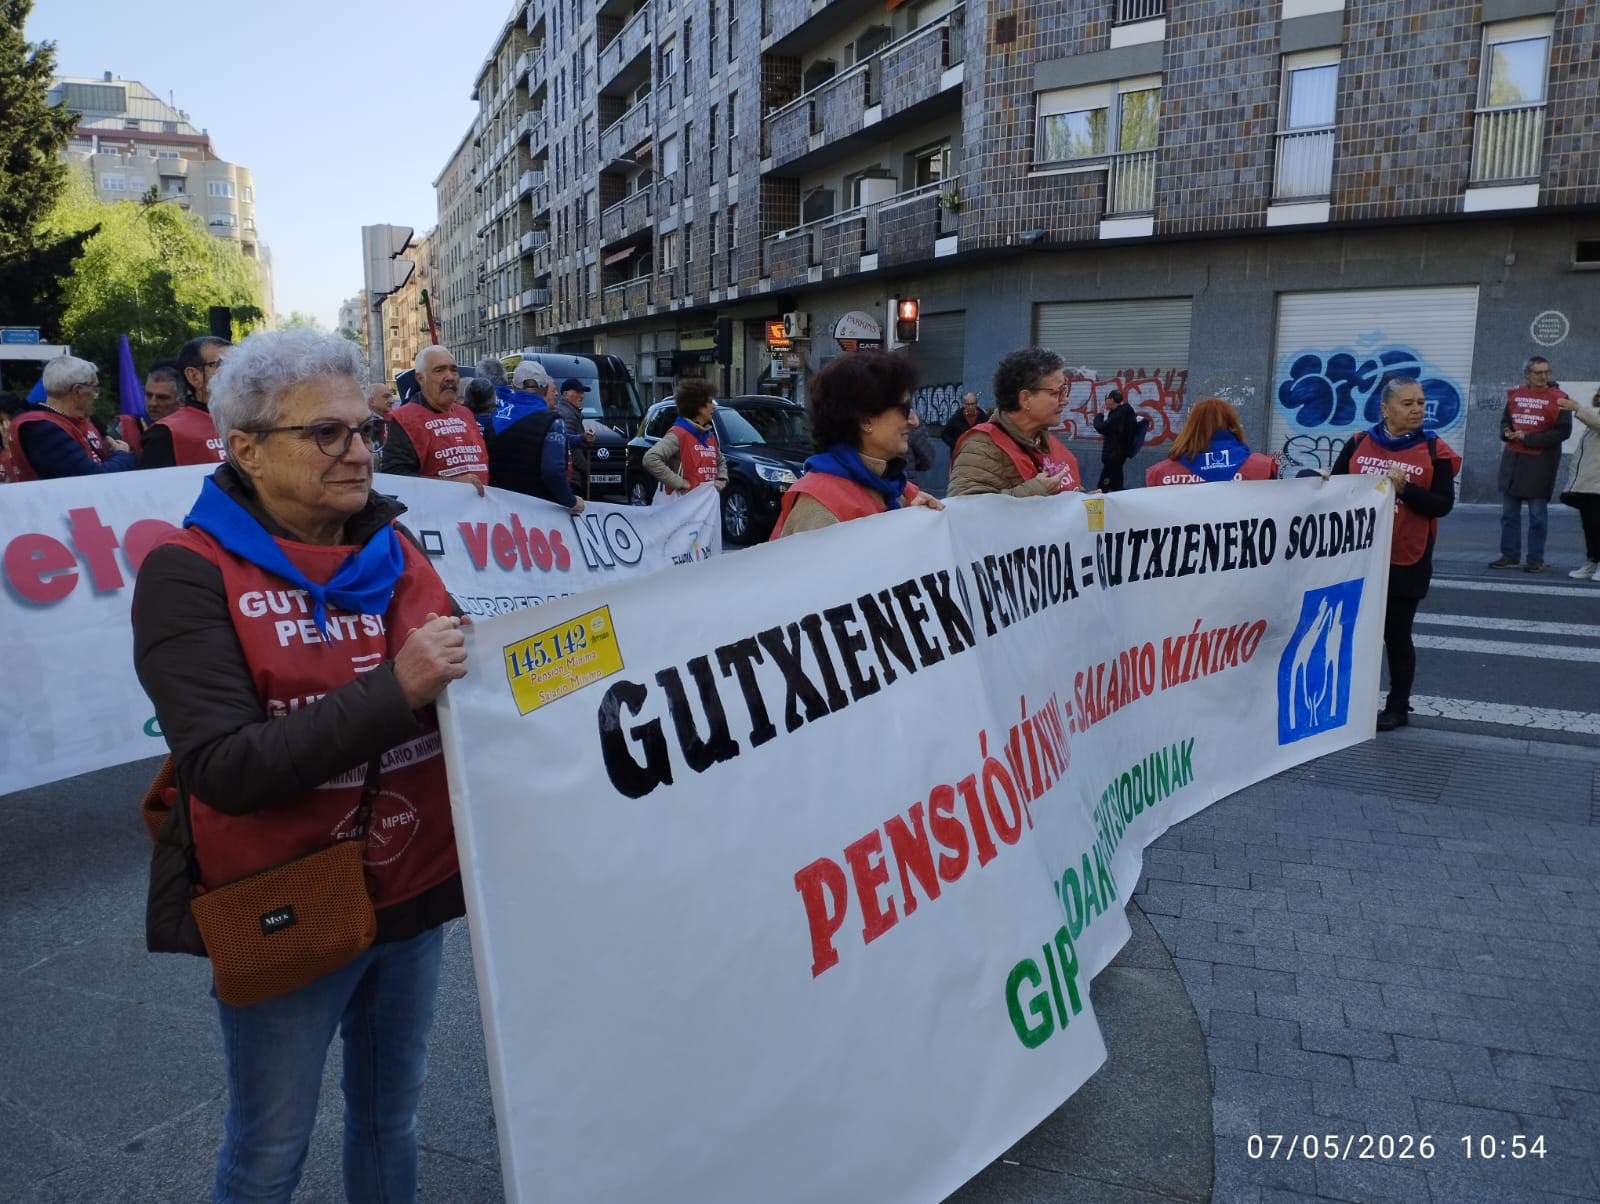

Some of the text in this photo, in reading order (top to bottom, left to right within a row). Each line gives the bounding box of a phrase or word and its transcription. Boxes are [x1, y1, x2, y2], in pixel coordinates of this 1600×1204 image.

[571, 511, 644, 569] NO
[971, 541, 1079, 637] PENTSIOA
[1081, 555, 1094, 587] =
[1096, 517, 1277, 591] GUTXIENEKO
[1285, 506, 1378, 560] SOLDATA
[508, 624, 588, 680] 145.142
[1074, 640, 1156, 733] SALARIO
[1160, 618, 1268, 691] MÍNIMO
[381, 810, 415, 829] MPEH
